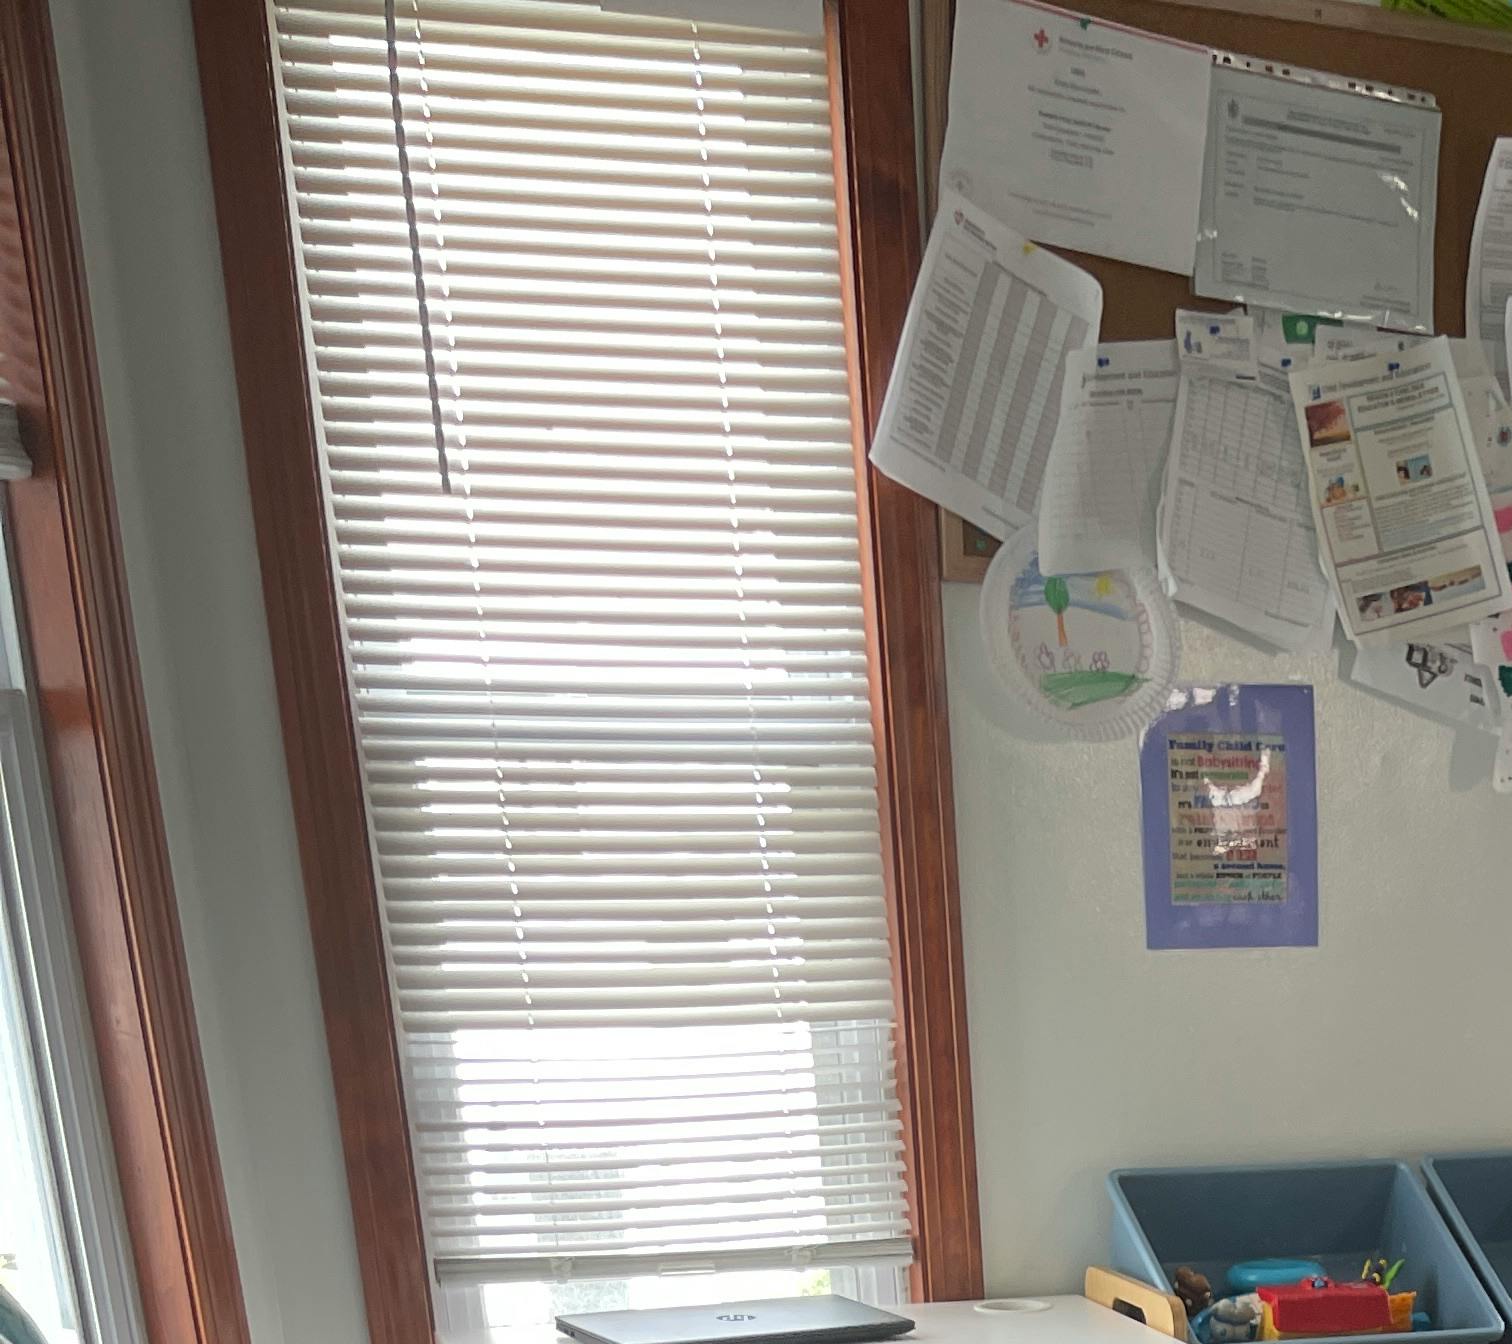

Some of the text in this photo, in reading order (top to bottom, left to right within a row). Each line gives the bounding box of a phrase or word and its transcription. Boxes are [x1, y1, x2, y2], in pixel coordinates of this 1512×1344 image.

[1168, 739, 1285, 752] Family Child Care
